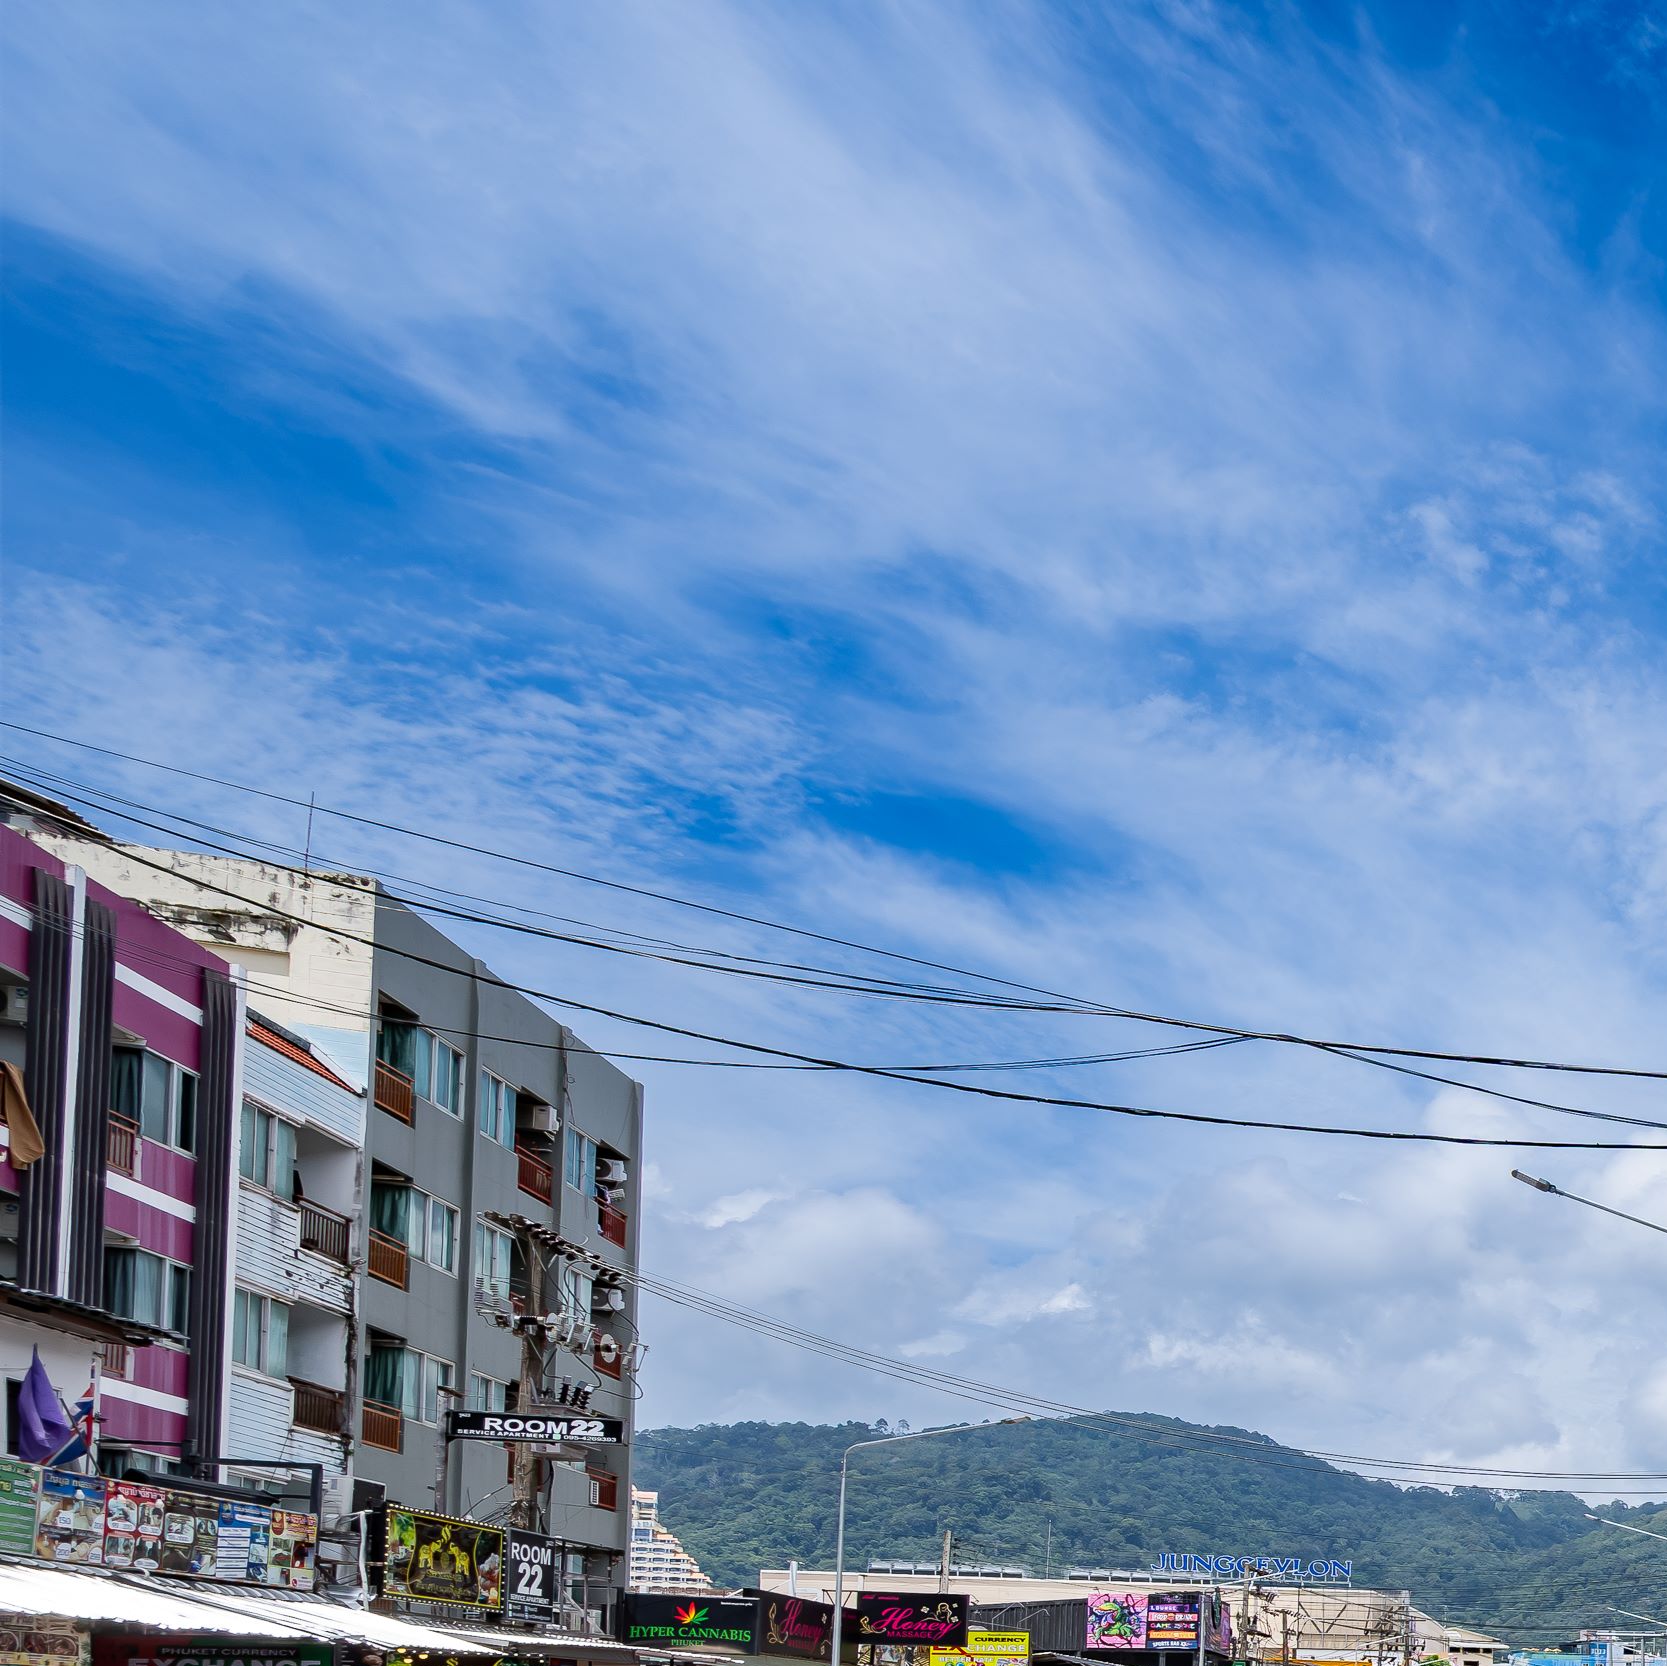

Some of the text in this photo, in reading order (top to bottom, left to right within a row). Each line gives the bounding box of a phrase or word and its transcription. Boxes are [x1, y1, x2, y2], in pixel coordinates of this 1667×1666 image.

[497, 1431, 549, 1439] APARTMENT
[511, 1542, 552, 1566] ROOM
[1151, 1552, 1352, 1578] JUNGCEYLON
[517, 1562, 543, 1597] 22
[873, 1606, 962, 1640] Honey
[630, 1626, 751, 1642] HYPER CANNABIS
[671, 1639, 706, 1647] PHUKET
[886, 1631, 934, 1639] MASSAGE
